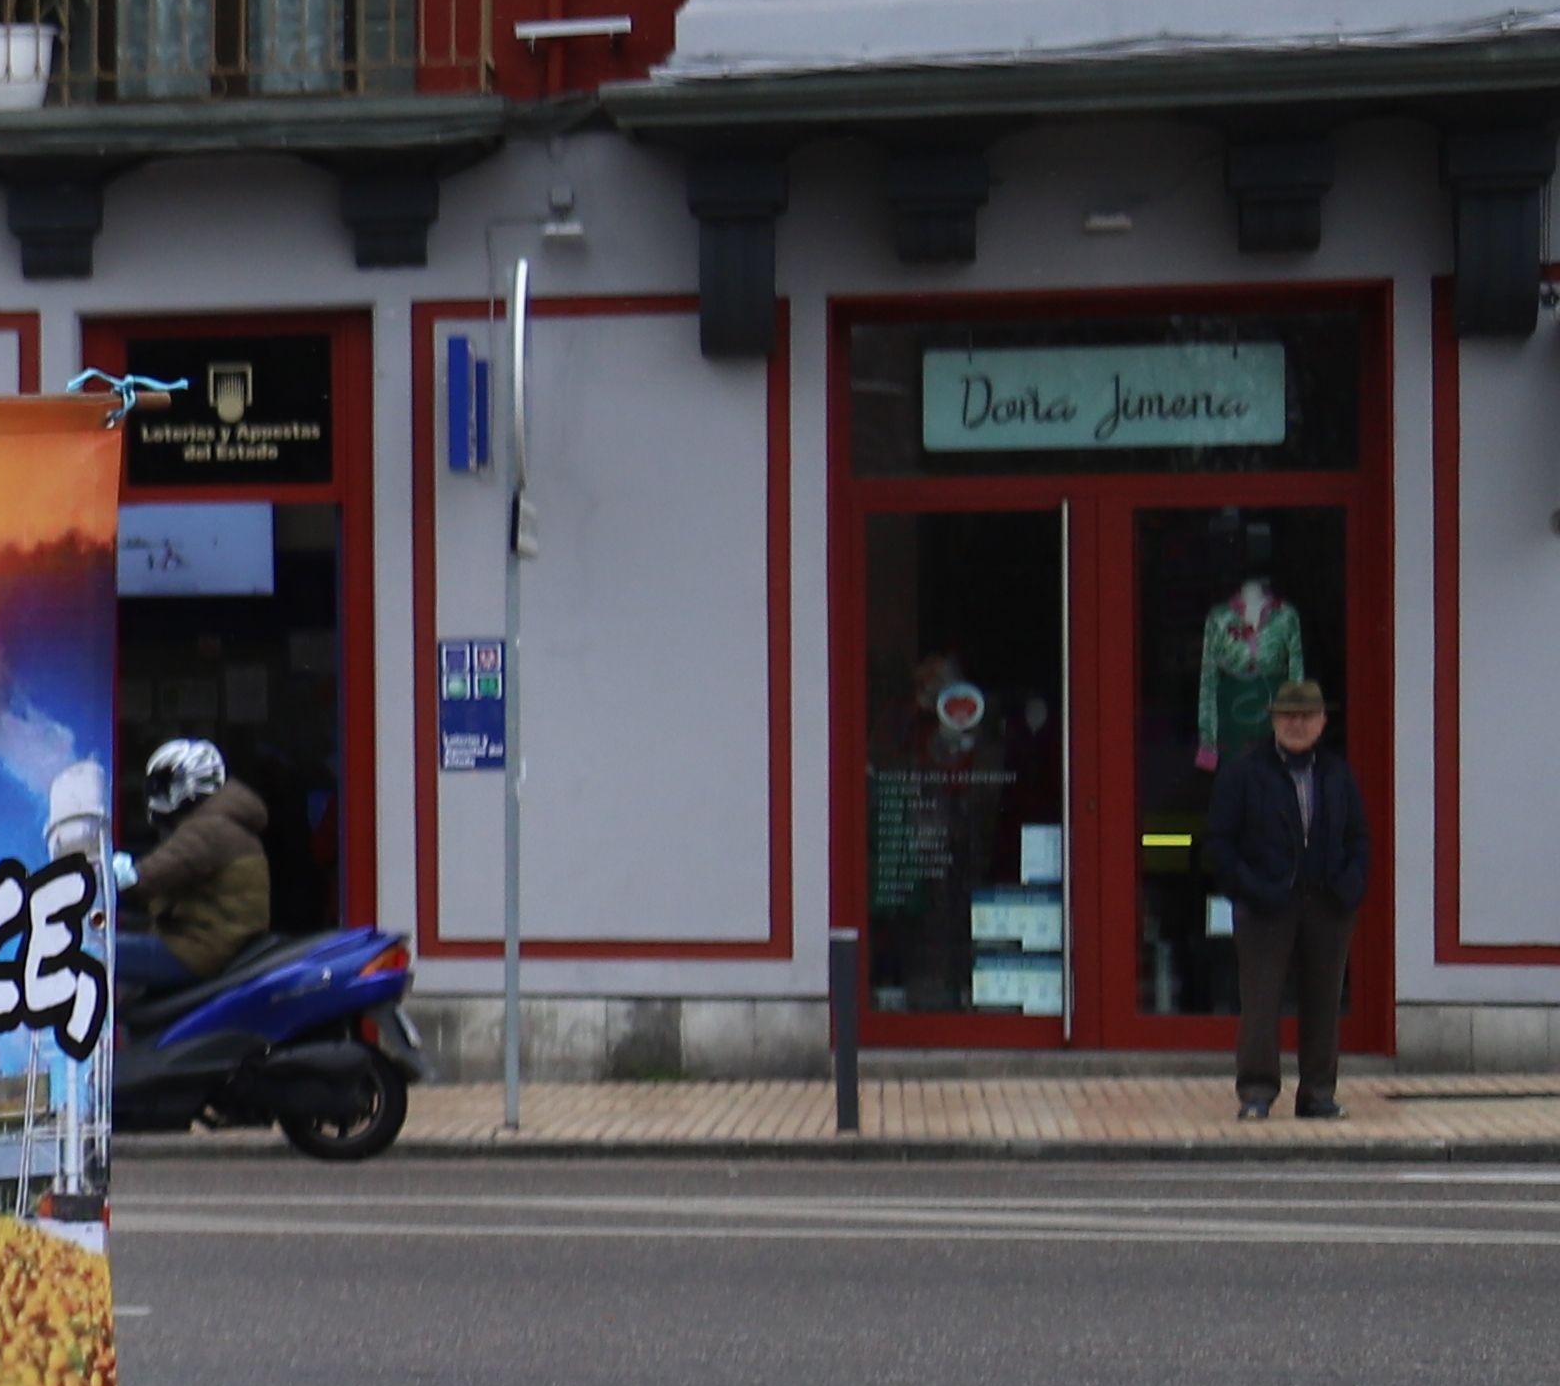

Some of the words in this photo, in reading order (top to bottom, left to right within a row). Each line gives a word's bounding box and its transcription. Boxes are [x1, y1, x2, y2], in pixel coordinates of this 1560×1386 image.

[961, 371, 1077, 430] Doña
[1094, 372, 1249, 441] Jimena
[220, 427, 231, 445] y
[236, 422, 320, 444] Apuestas
[183, 444, 211, 461] del
[216, 443, 278, 461] Estado
